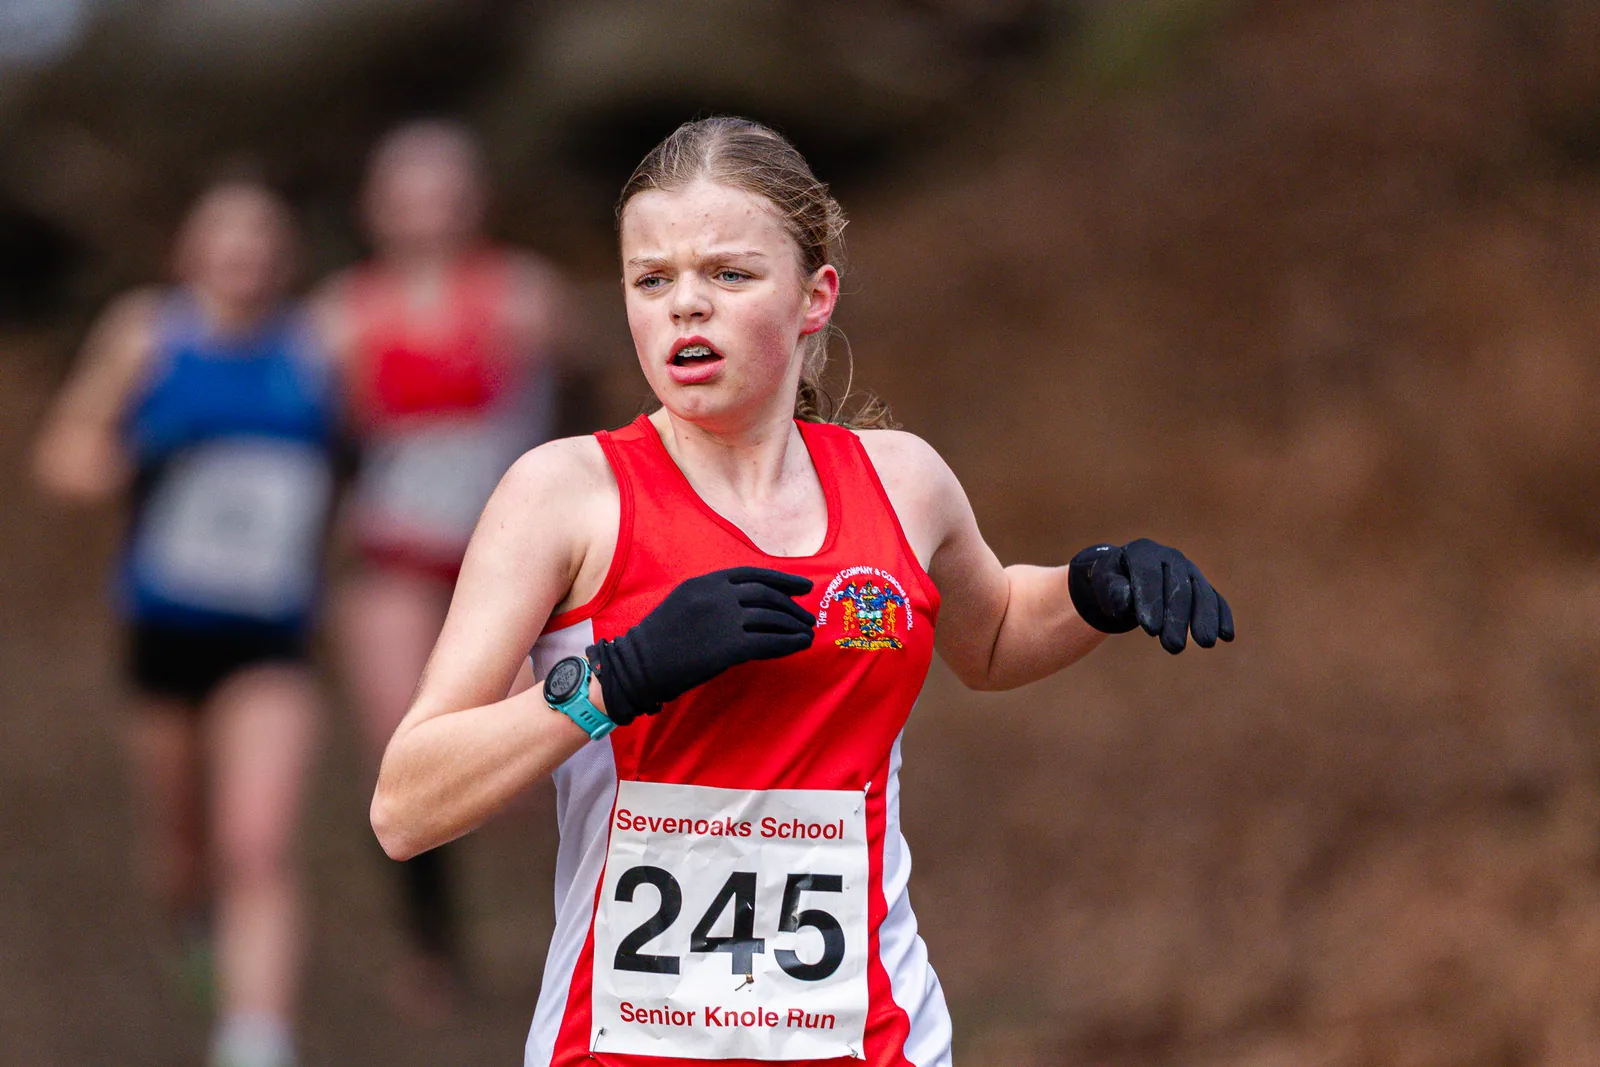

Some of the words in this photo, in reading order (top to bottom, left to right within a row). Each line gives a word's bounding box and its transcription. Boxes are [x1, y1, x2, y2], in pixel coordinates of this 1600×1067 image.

[816, 610, 827, 628] THE
[840, 566, 873, 579] COMPANY
[616, 809, 752, 837] Sevenoaks
[760, 817, 844, 839] School
[613, 865, 846, 982] 245
[620, 1002, 696, 1026] Senior
[704, 1006, 779, 1027] Knole
[787, 1008, 836, 1029] Run
